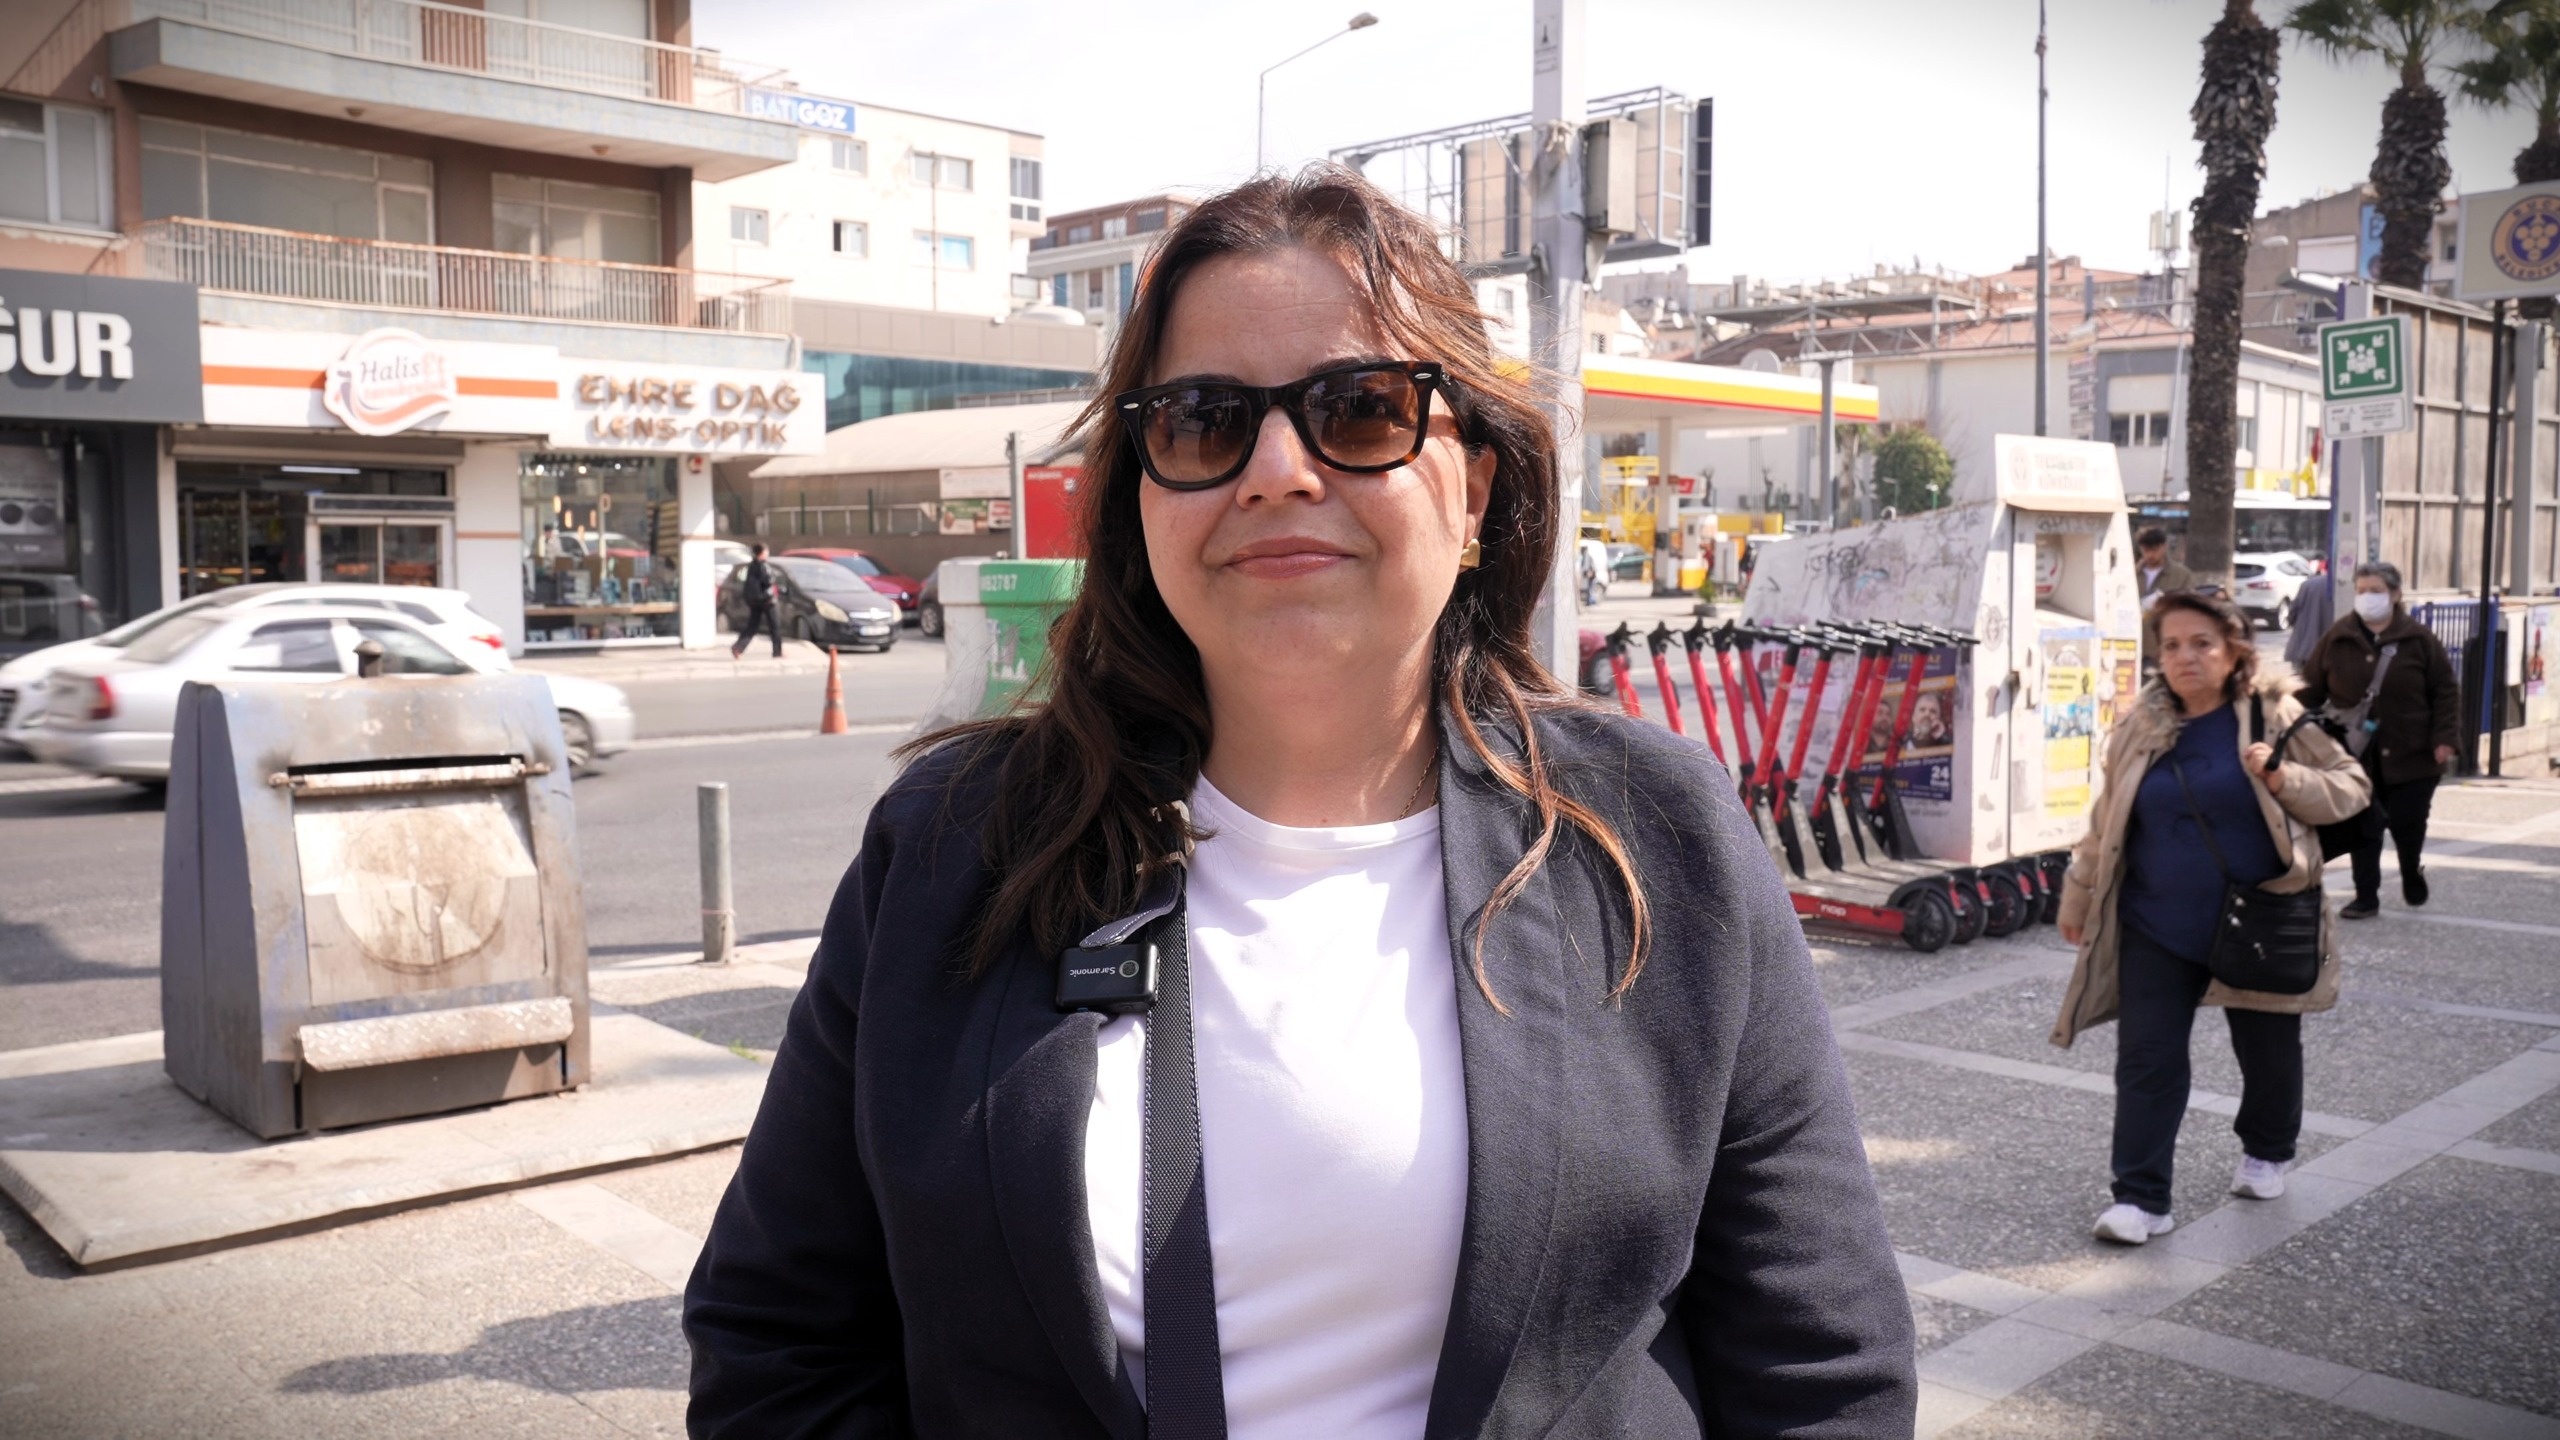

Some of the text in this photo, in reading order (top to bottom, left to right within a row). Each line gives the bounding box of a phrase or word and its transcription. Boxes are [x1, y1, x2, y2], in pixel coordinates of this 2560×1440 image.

[360, 355, 420, 383] Halis
[579, 373, 800, 413] EMRE DAĞ
[1931, 765, 1950, 780] 24
[1069, 966, 1116, 978] Saramonic
